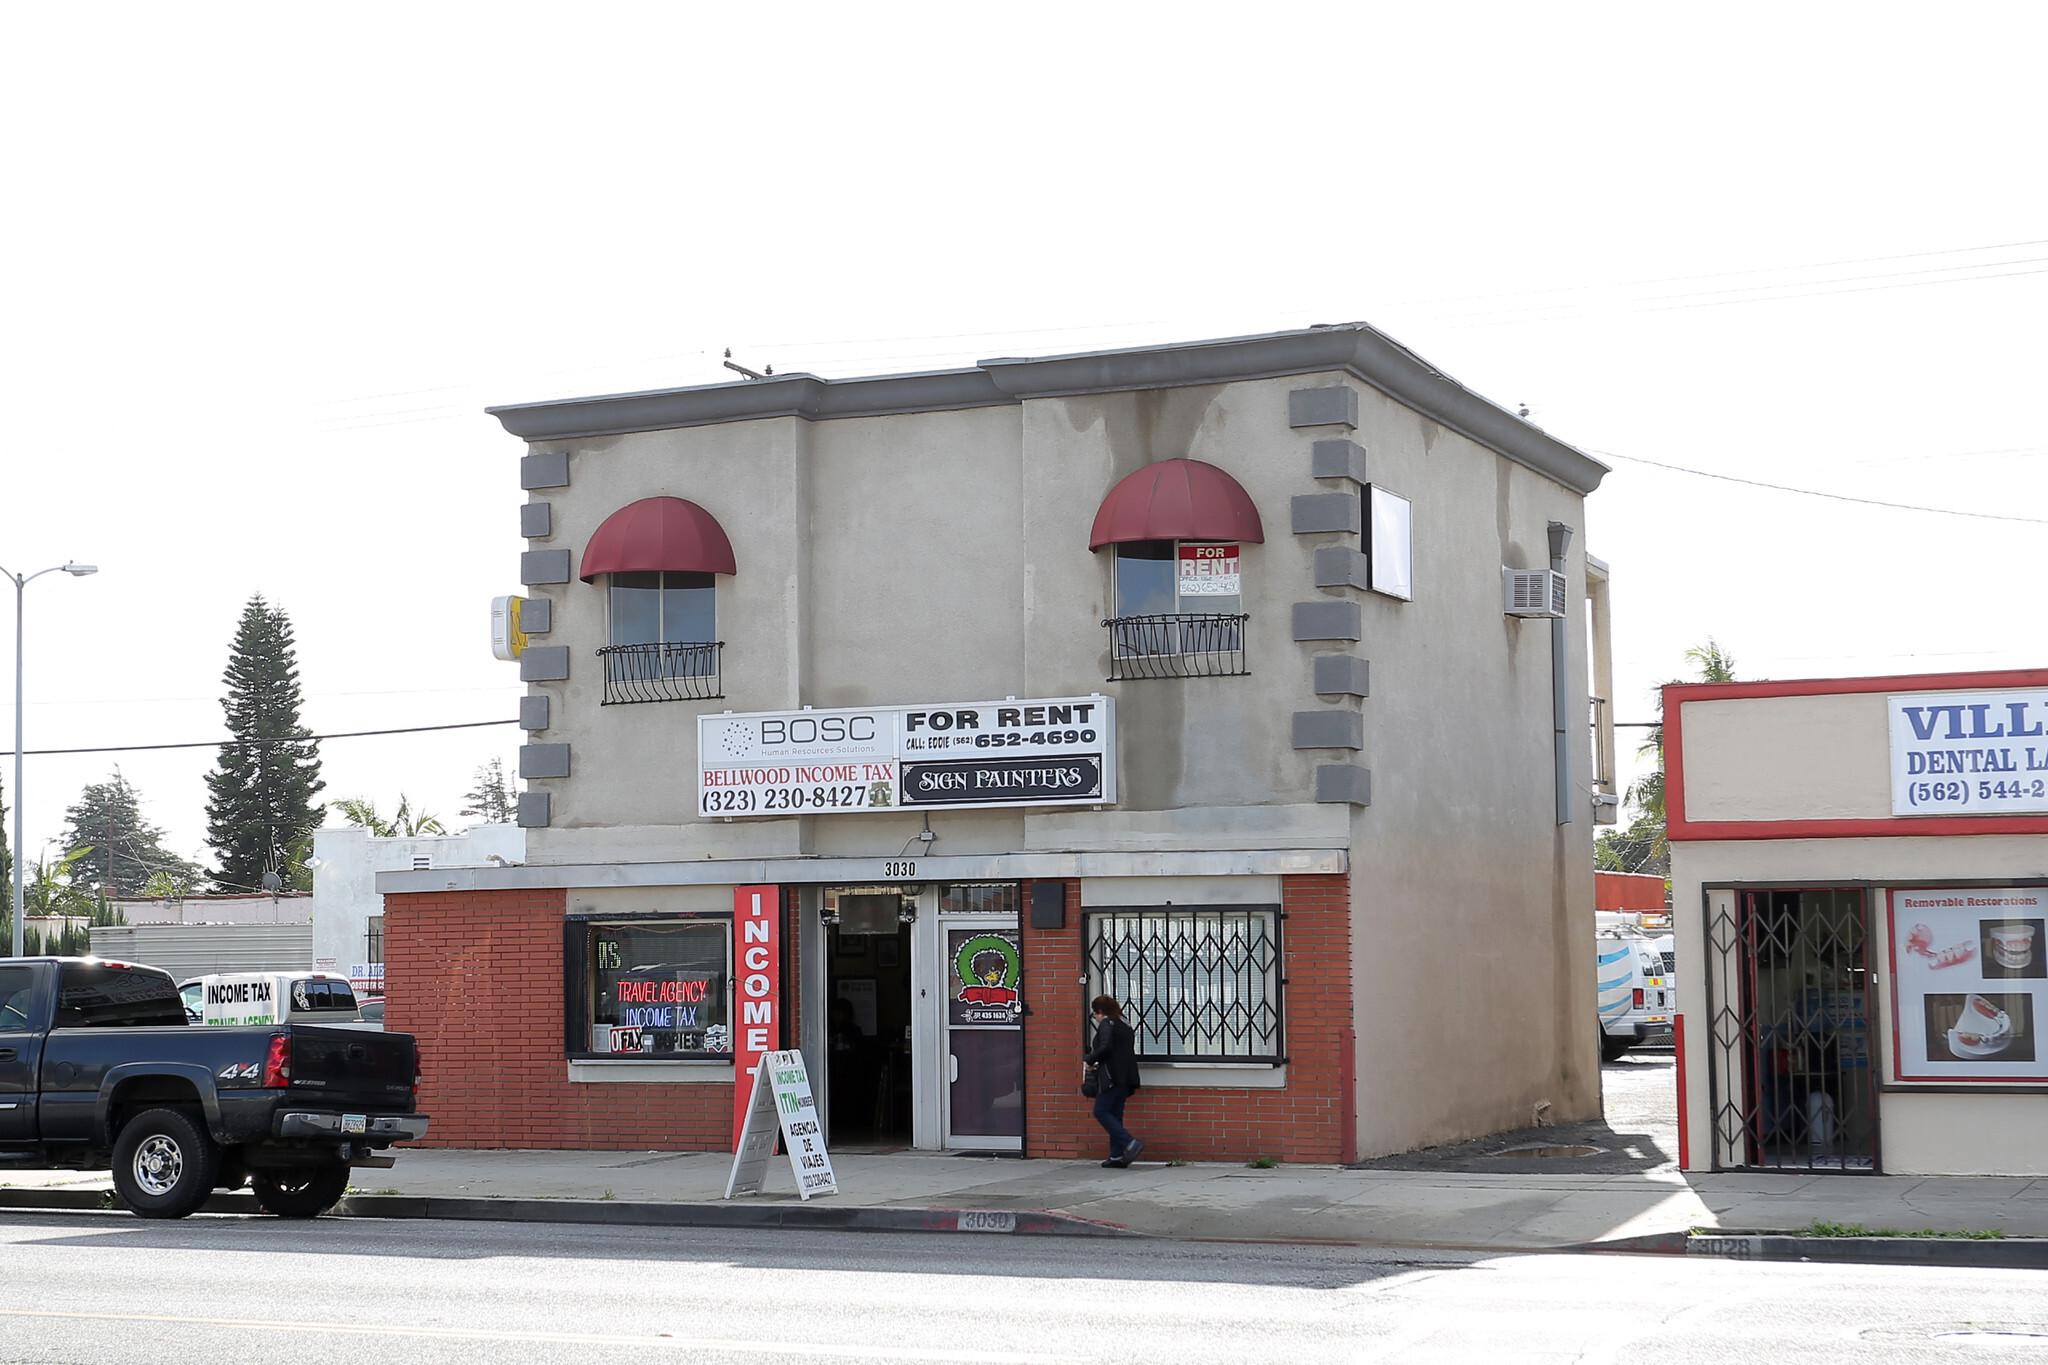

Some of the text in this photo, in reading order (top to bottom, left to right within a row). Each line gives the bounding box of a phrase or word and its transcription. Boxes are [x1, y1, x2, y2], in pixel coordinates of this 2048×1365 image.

[1196, 547, 1225, 558] FOR
[1181, 557, 1238, 576] RENT
[906, 704, 1095, 732] FOR RENT
[1901, 702, 2048, 740] VILL
[761, 716, 875, 745] BOSC
[906, 738, 926, 751] CALL:
[952, 736, 974, 746] (562)
[974, 729, 1097, 748] 652-4690
[761, 745, 875, 757] Human Resources Solutions
[1907, 747, 2048, 775] DENTAL L
[703, 764, 894, 787] BELLWOOD INCOME TAX
[918, 766, 1083, 792] SIGN PAINTERS
[702, 786, 867, 812] (323) 230-8427
[1909, 780, 1970, 806] (562)
[884, 862, 916, 877] 3030
[1904, 896, 2039, 908] Removable Restorations
[351, 965, 367, 977] DR.
[743, 893, 772, 1051] INCOME
[207, 983, 249, 1005] INCOME
[251, 982, 271, 1002] TAX
[617, 980, 708, 1003] TRAVEL AGENCY
[625, 1006, 698, 1028] INCOME TAX
[775, 1070, 797, 1086] INCOME
[778, 1092, 800, 1114] ITIN
[789, 1120, 819, 1138] AGENCIA
[802, 1138, 814, 1153] DE
[799, 1153, 825, 1170] VIAJES
